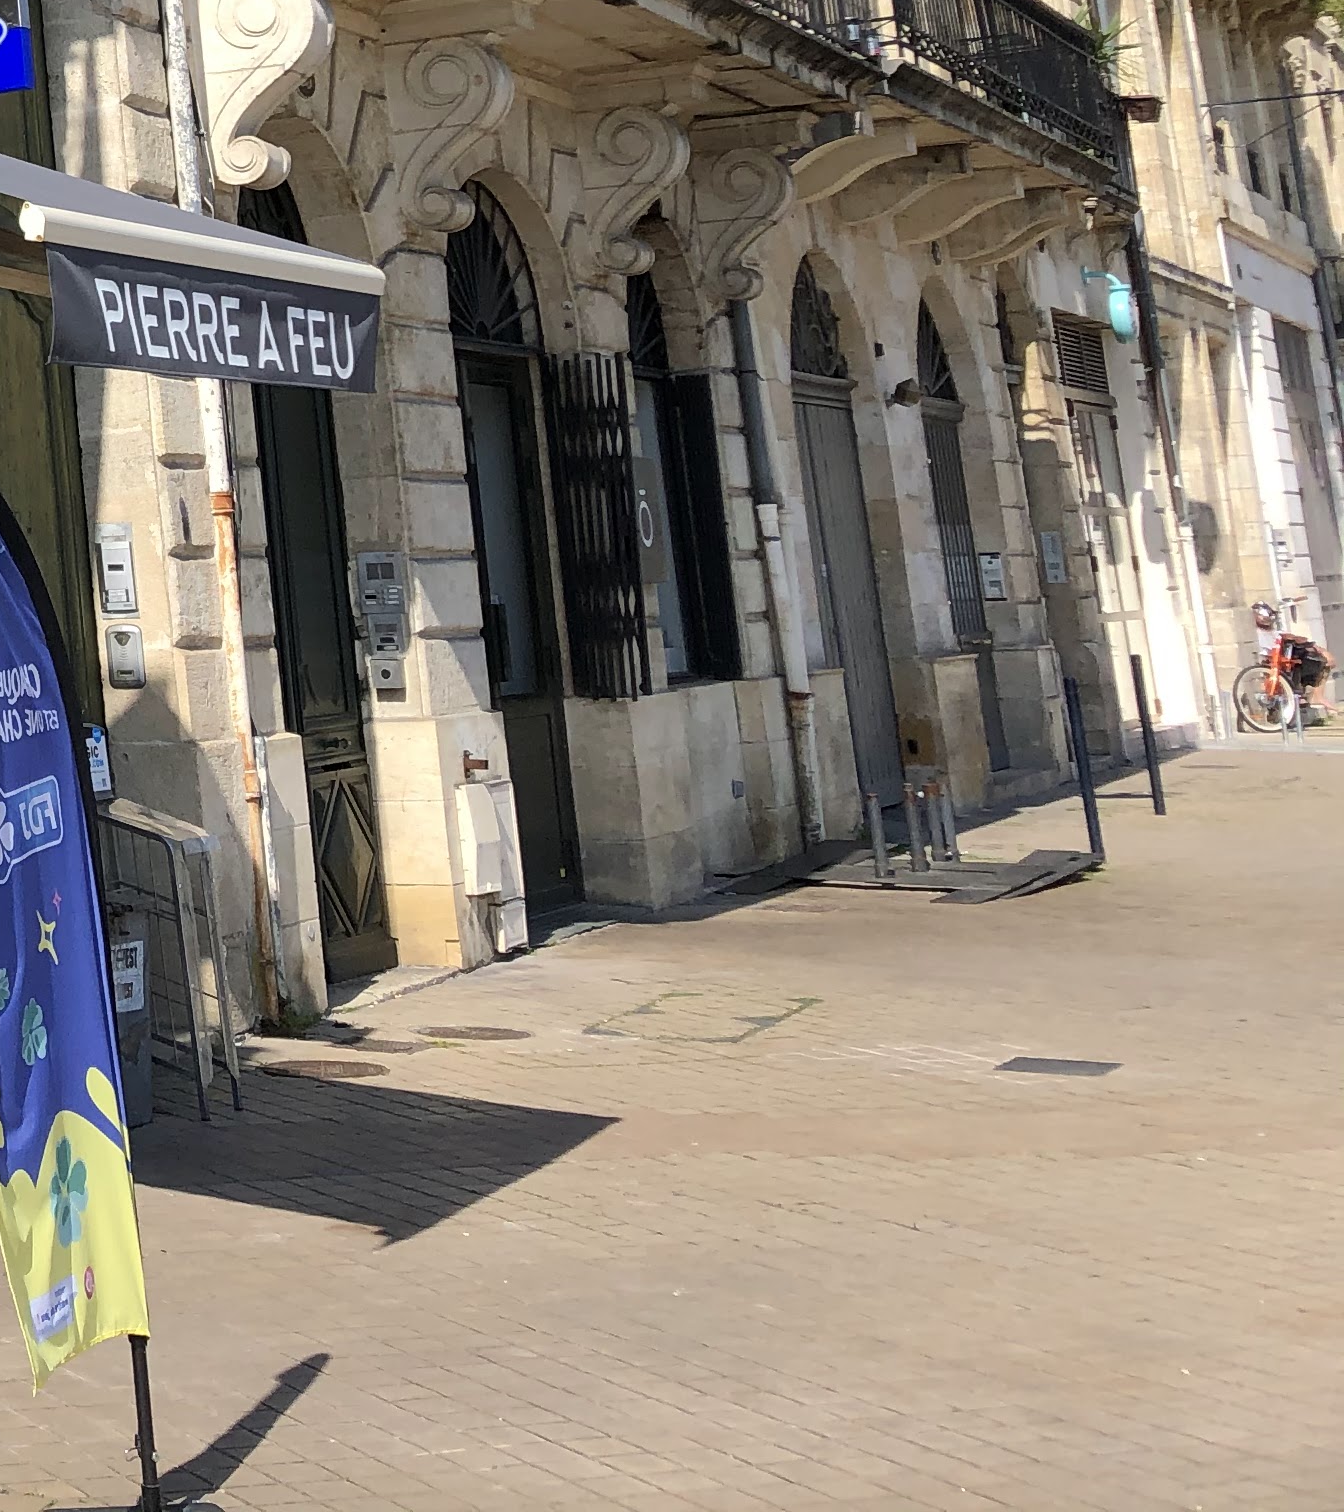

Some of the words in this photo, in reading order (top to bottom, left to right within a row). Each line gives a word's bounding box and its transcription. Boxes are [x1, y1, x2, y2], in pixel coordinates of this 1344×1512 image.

[95, 278, 249, 368] PIERRE
[258, 301, 284, 372] A
[287, 306, 354, 380] FEU
